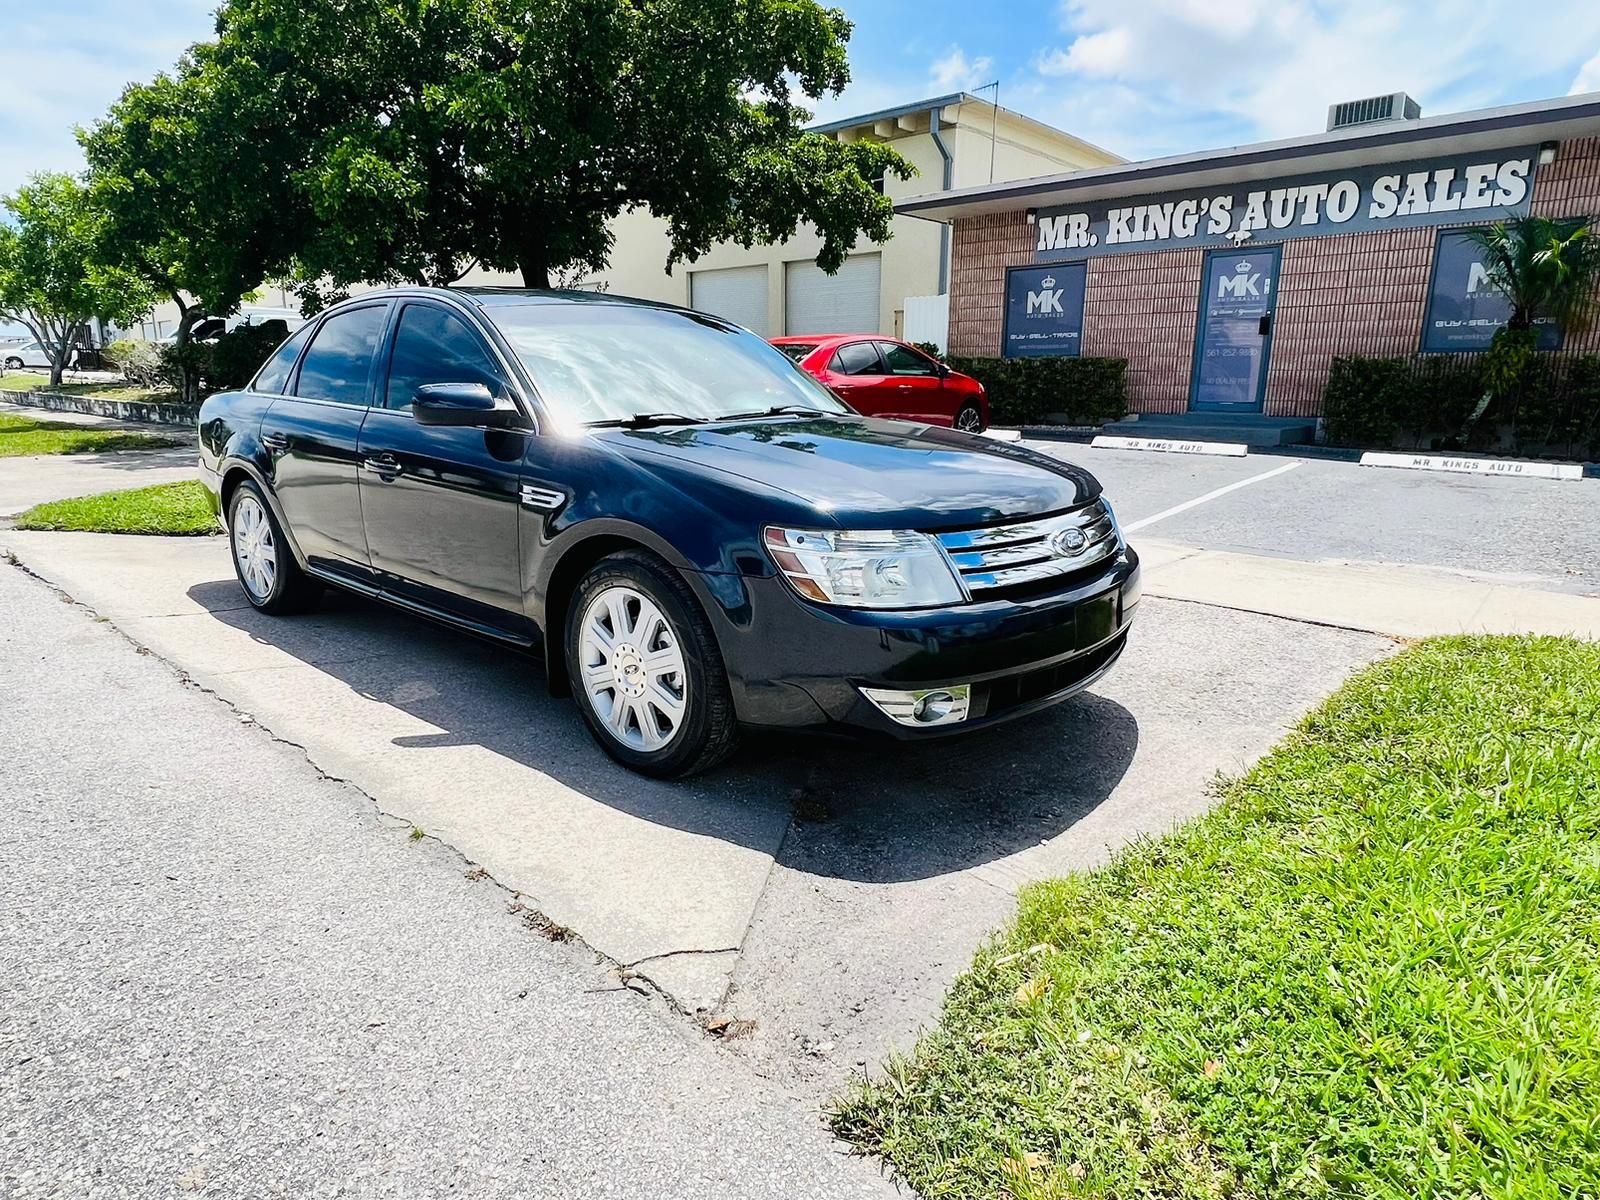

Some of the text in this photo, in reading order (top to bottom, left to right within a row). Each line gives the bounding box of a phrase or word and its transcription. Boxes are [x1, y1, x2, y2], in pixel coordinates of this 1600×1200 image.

[1037, 159, 1531, 251] MR. KING'S AUTO SALES
[1217, 273, 1260, 297] MK
[1026, 289, 1064, 313] MK
[1146, 442, 1173, 450] KINGS
[1180, 444, 1204, 452] AUTO
[1442, 460, 1479, 470] KINGS
[1488, 463, 1523, 473] AUTO
